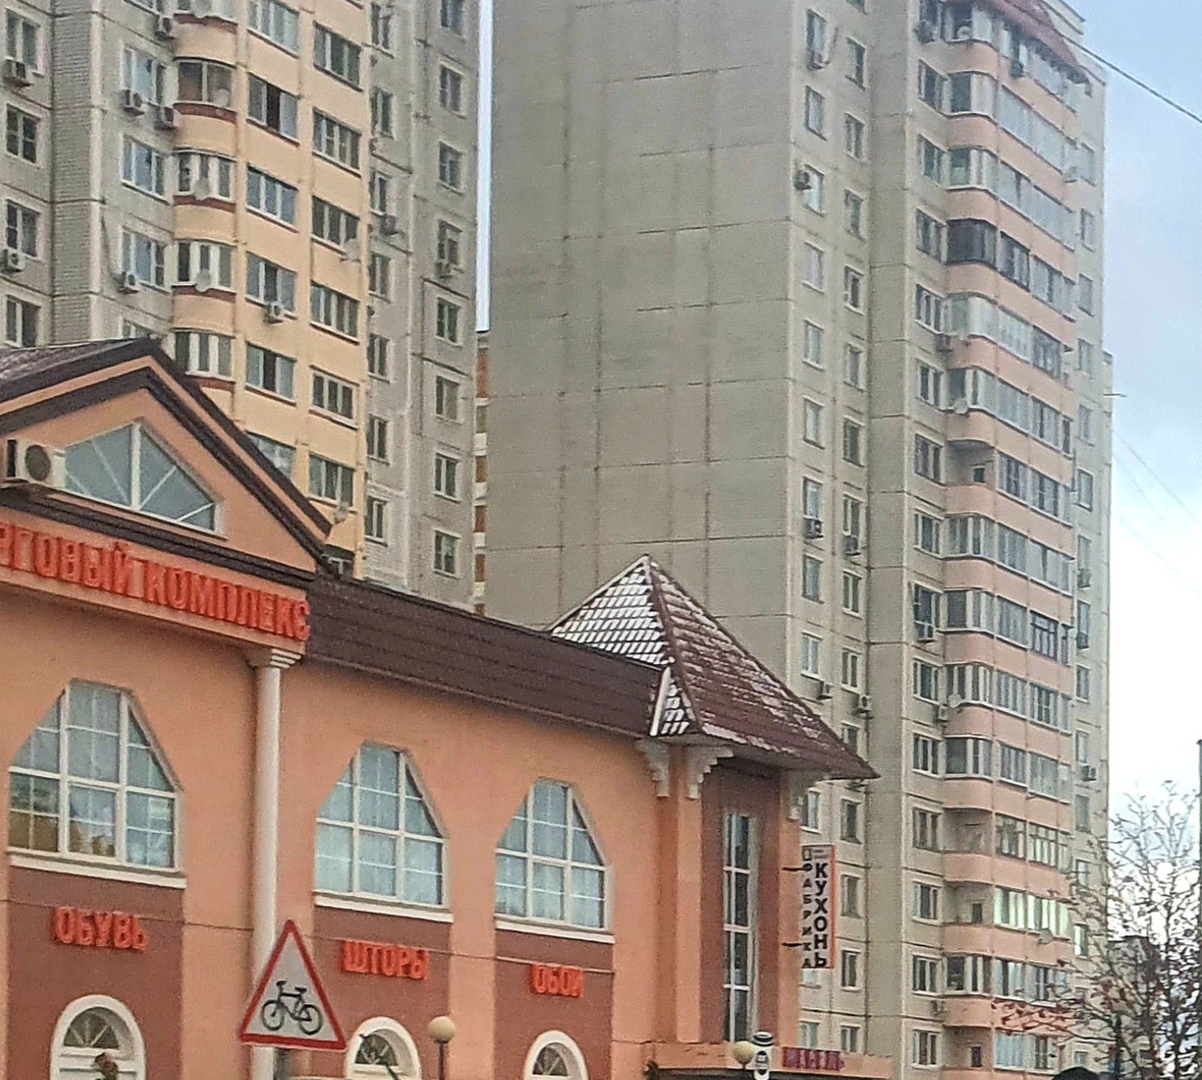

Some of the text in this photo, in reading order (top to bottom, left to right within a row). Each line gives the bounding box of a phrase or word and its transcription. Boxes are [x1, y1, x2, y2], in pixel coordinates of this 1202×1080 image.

[145, 562, 310, 641] КОМПЛЕКС
[54, 907, 149, 950] ОБУВЬ
[814, 862, 829, 967] КУХОНЬ
[342, 940, 428, 980] ШТОРЫ
[530, 964, 583, 998] ОБОИ
